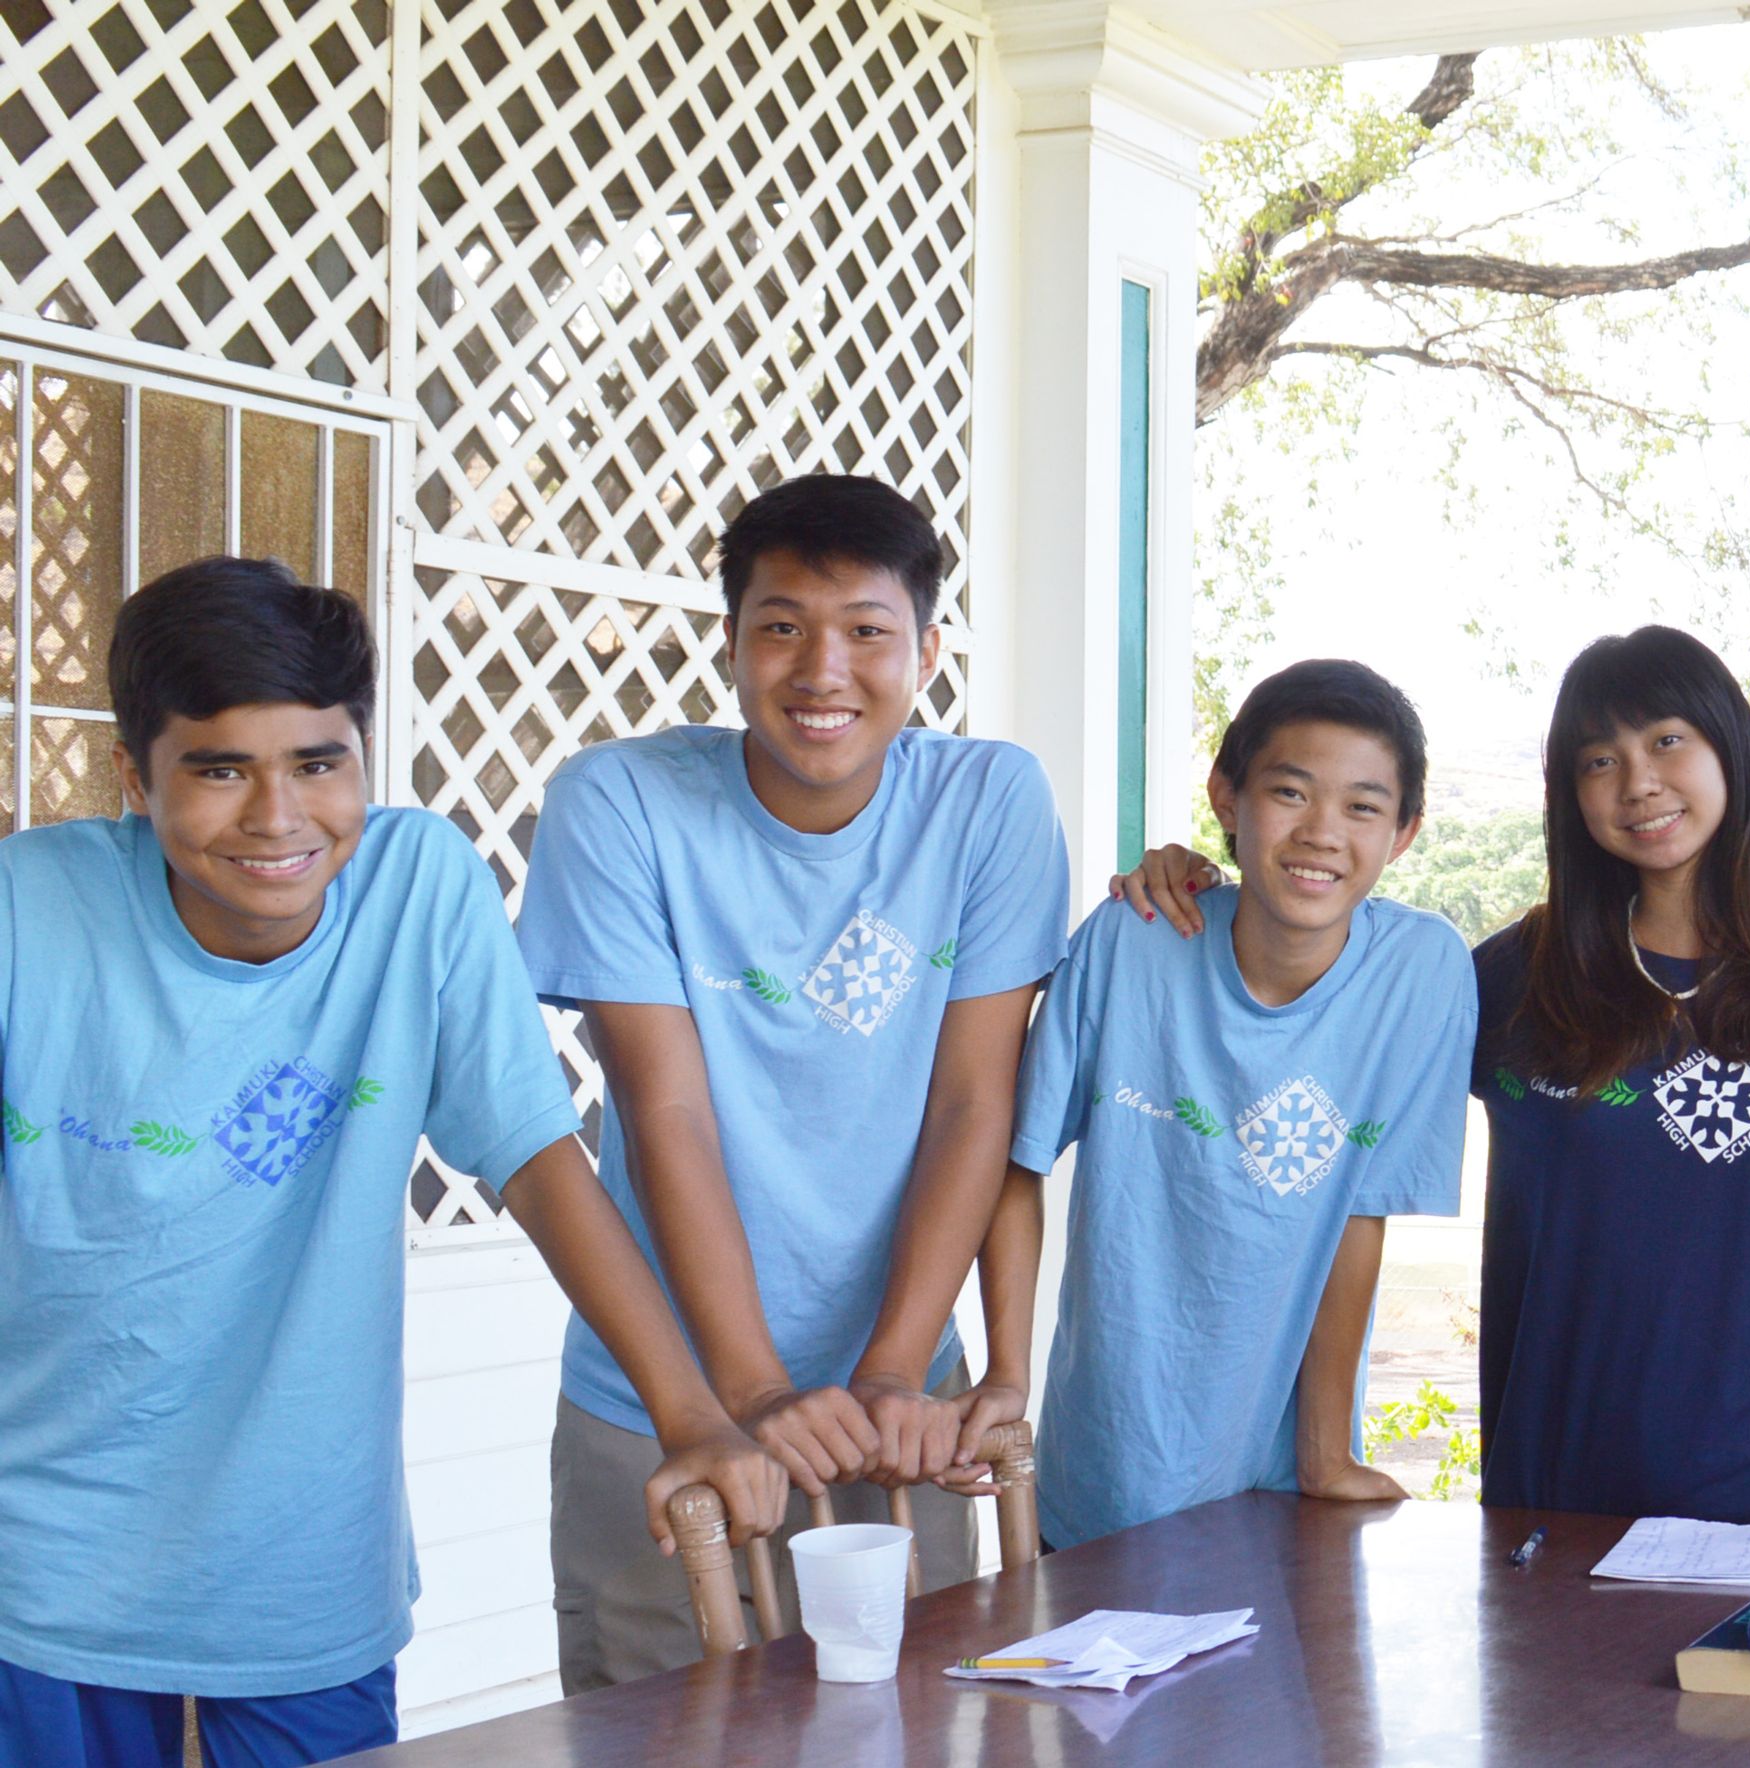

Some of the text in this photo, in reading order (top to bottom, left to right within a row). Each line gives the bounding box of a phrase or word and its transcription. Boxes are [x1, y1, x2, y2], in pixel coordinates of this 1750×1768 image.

[814, 1006, 850, 1035] HIGH
[1652, 1049, 1706, 1087] KAIMU
[211, 1059, 280, 1128] KAIMUKI
[287, 1117, 343, 1178] SCHOOL
[1656, 1112, 1690, 1151] HIGH
[221, 1158, 257, 1188] HIGH
[1239, 1151, 1268, 1187] HIGH
